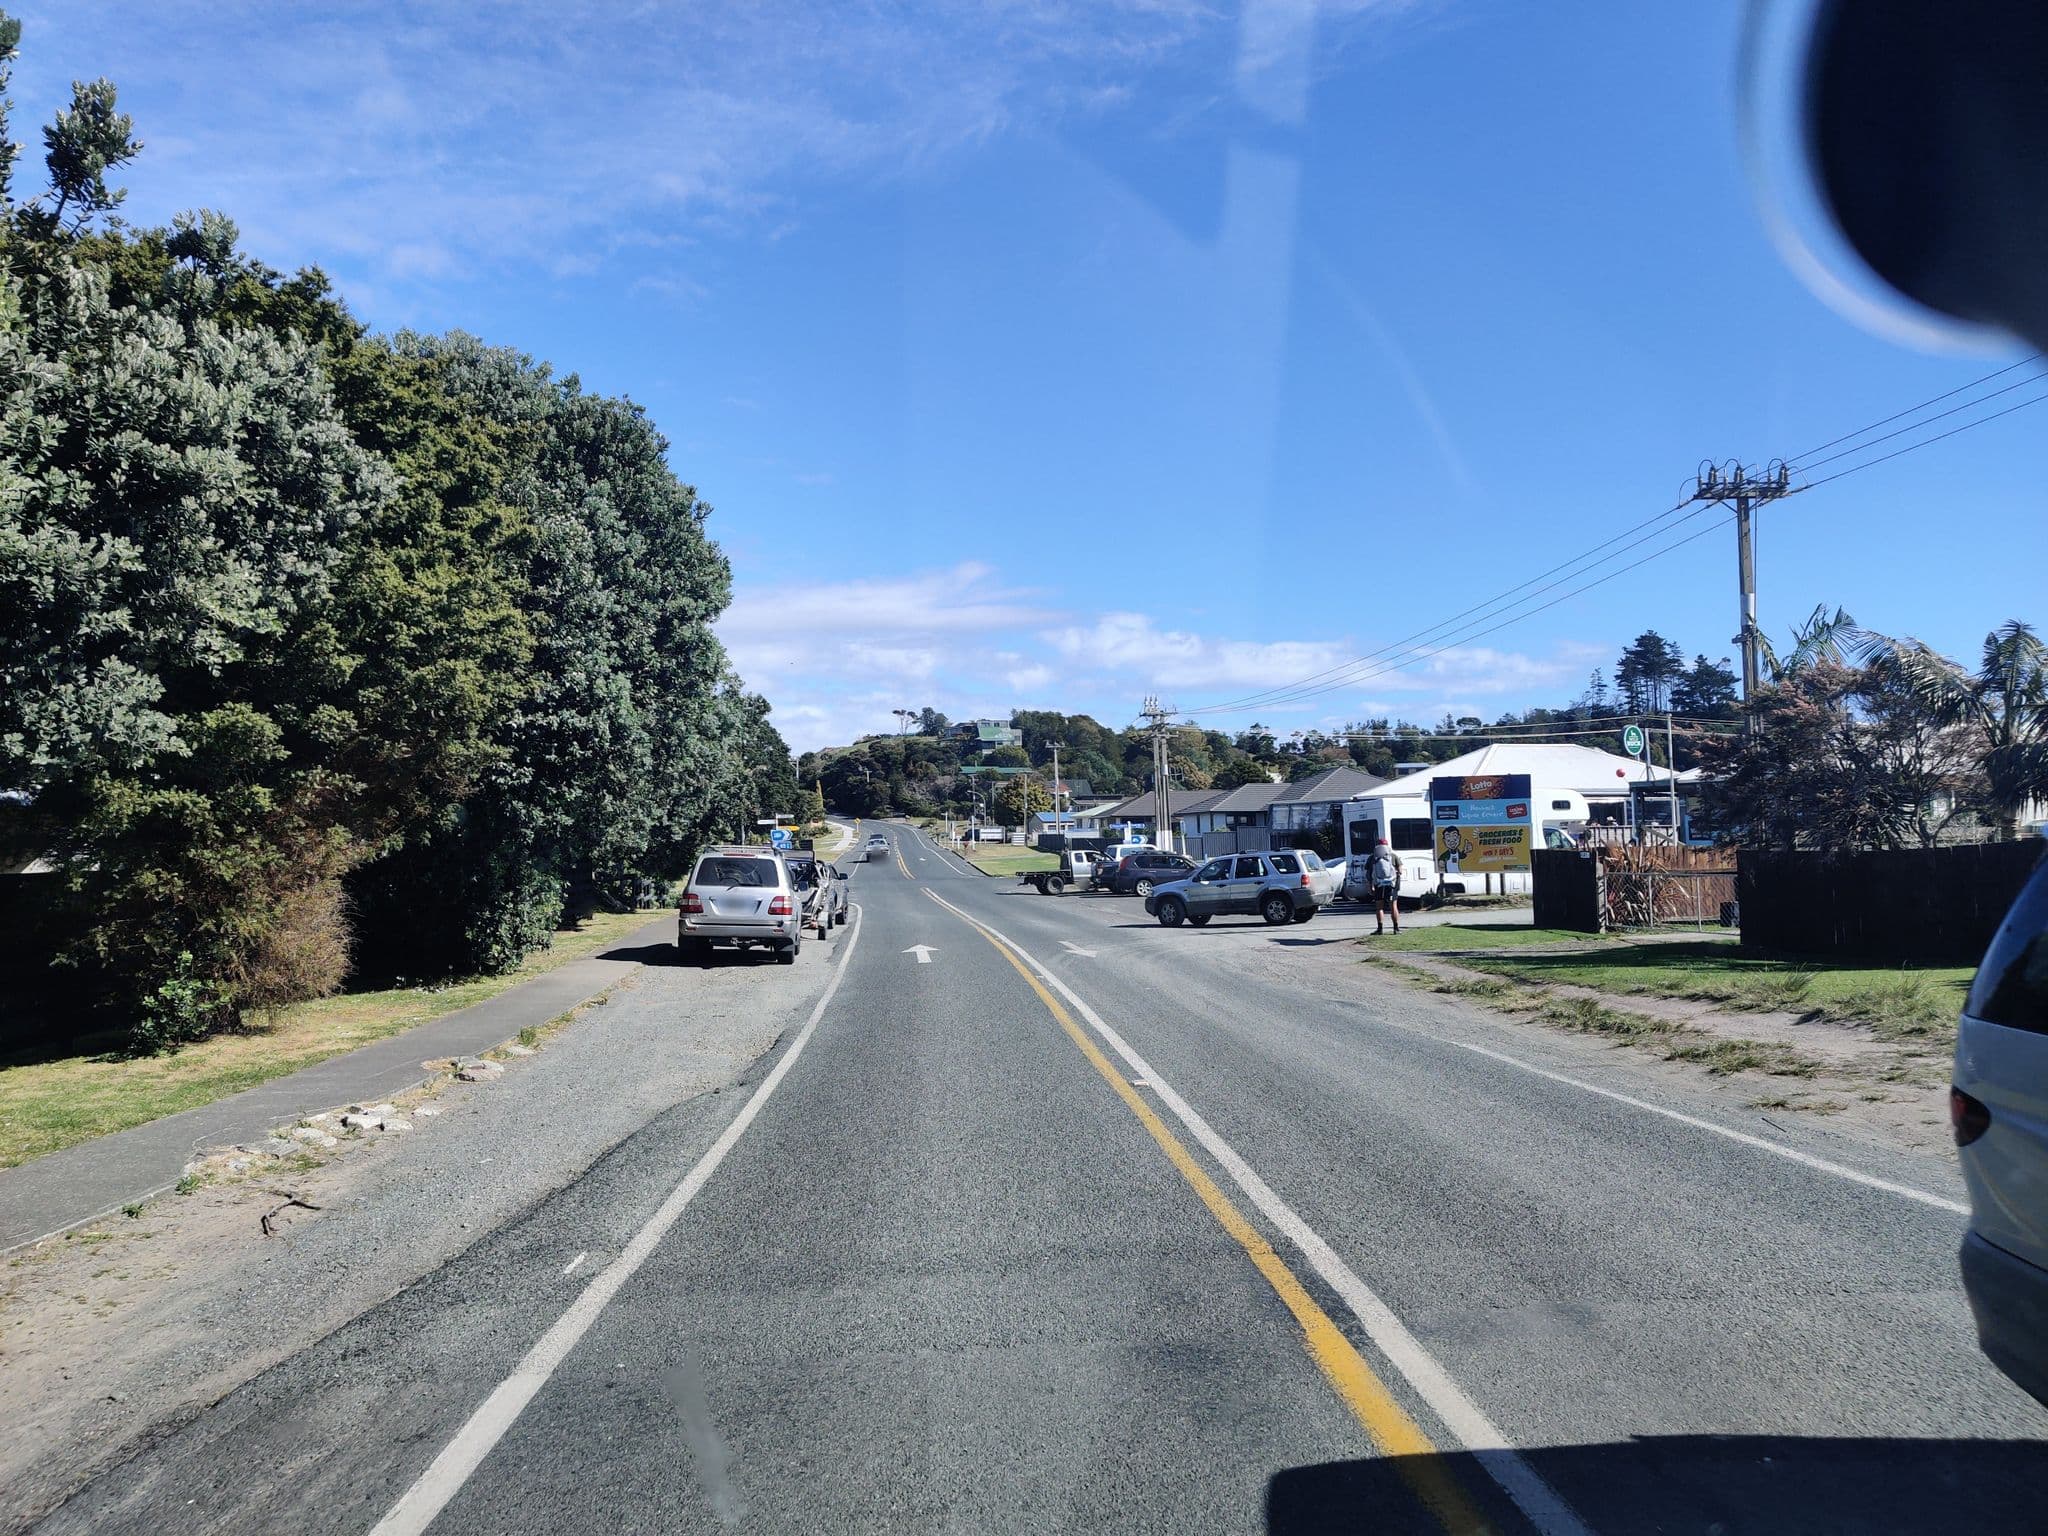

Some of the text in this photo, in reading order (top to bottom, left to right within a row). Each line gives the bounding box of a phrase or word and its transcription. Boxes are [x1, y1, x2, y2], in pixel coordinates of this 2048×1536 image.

[1470, 780, 1492, 791] Lotto
[1478, 829, 1518, 838] GROCERIES
[1502, 836, 1522, 845] FOOD
